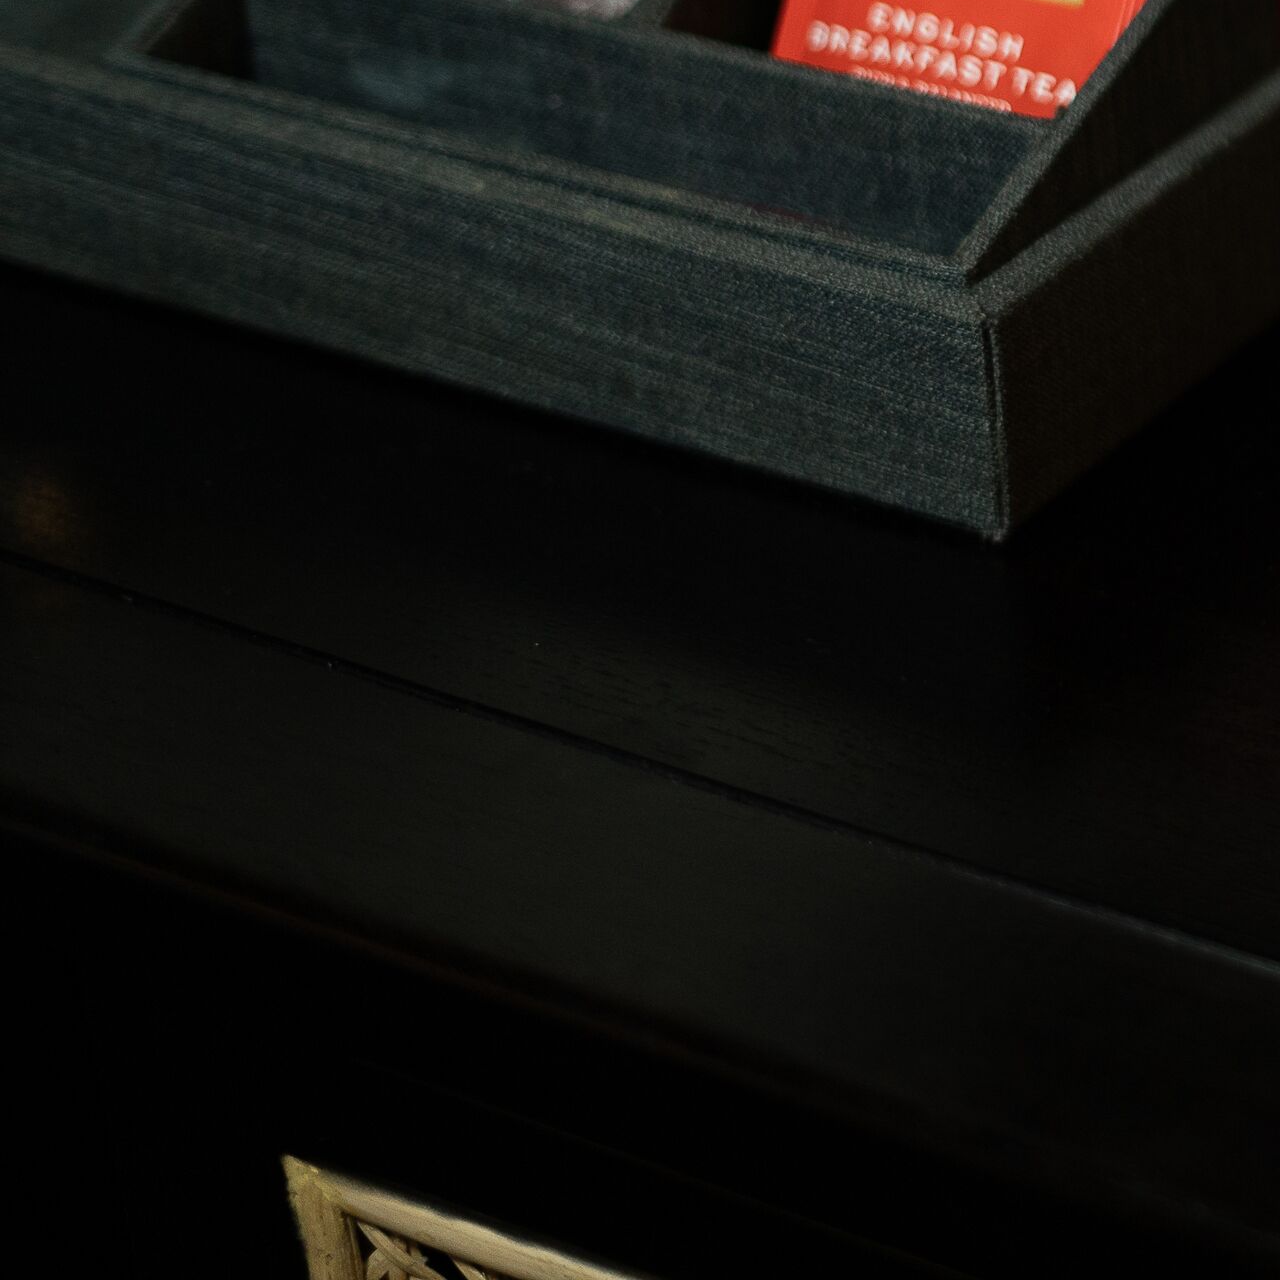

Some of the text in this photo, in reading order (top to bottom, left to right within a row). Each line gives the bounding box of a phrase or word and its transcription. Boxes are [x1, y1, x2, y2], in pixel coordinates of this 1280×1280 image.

[807, 21, 1006, 90] BREAKFAST
[1012, 67, 1076, 105] TEA
[868, 2, 1024, 62] ENGLISH
